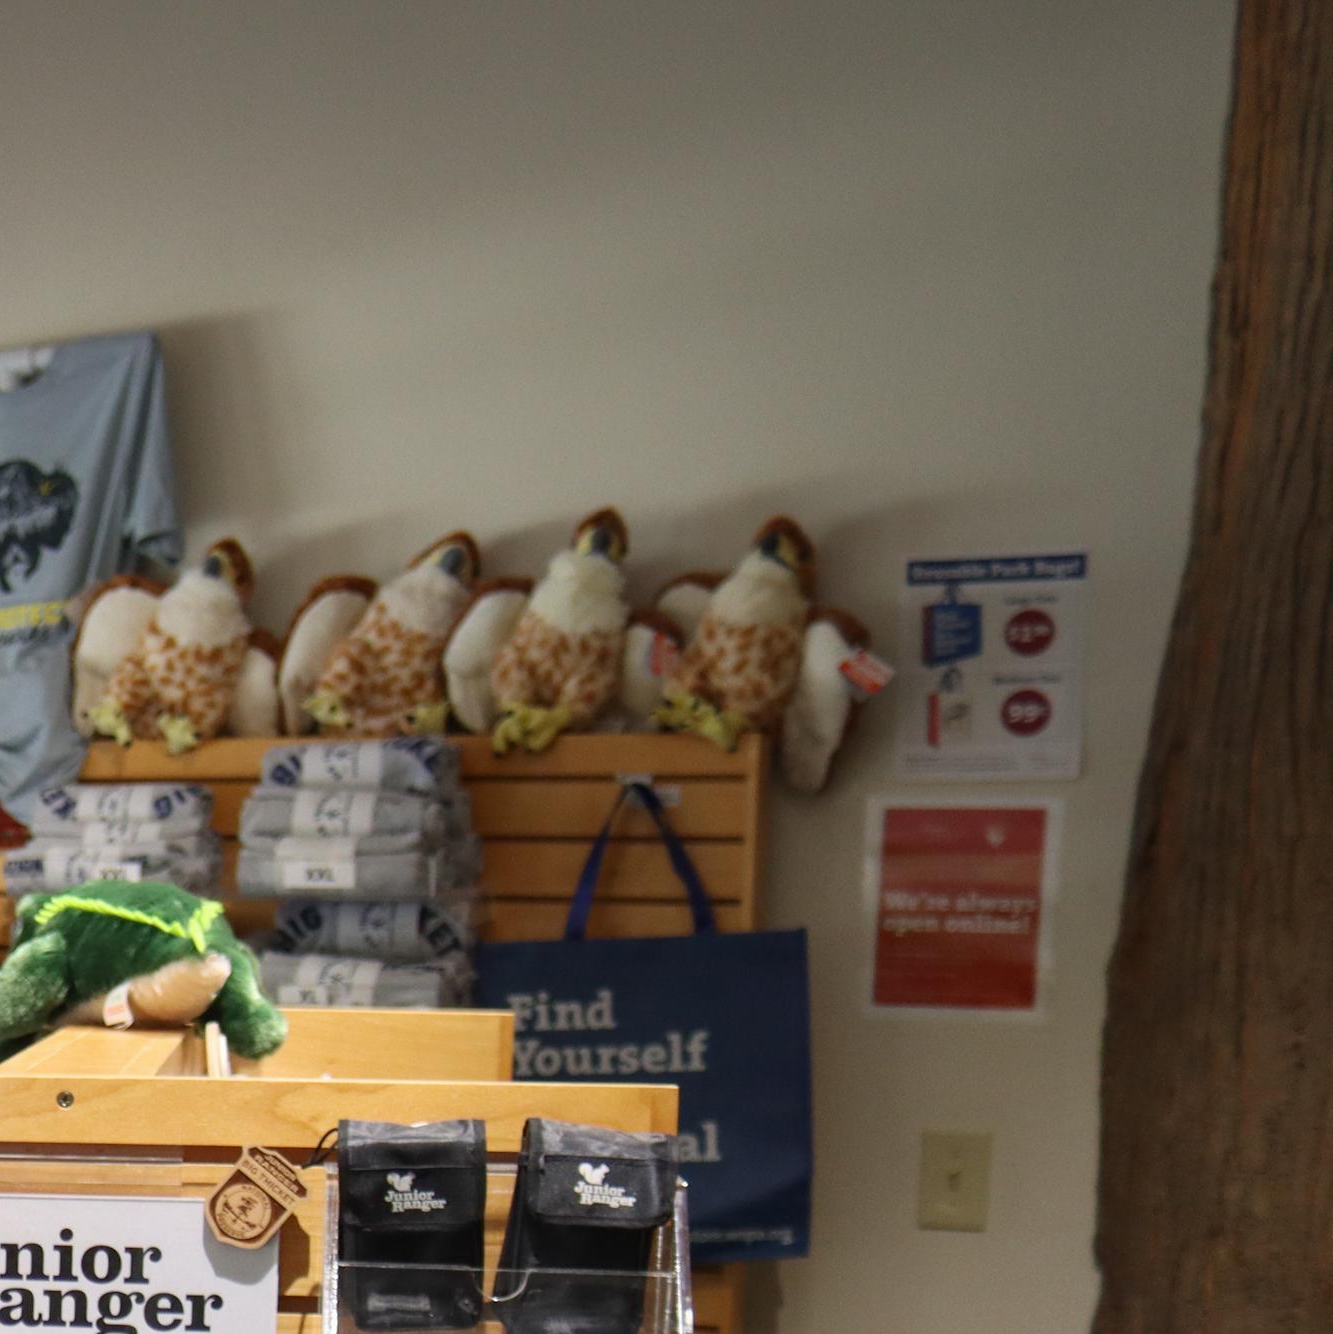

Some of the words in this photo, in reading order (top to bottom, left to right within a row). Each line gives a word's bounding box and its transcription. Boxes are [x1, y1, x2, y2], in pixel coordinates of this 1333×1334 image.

[508, 988, 616, 1031] Find
[514, 1031, 709, 1077] Yourself
[385, 1189, 435, 1202] Junior
[574, 1181, 626, 1198] Junior
[391, 1197, 447, 1213] Ranger
[579, 1193, 636, 1208] Ranger
